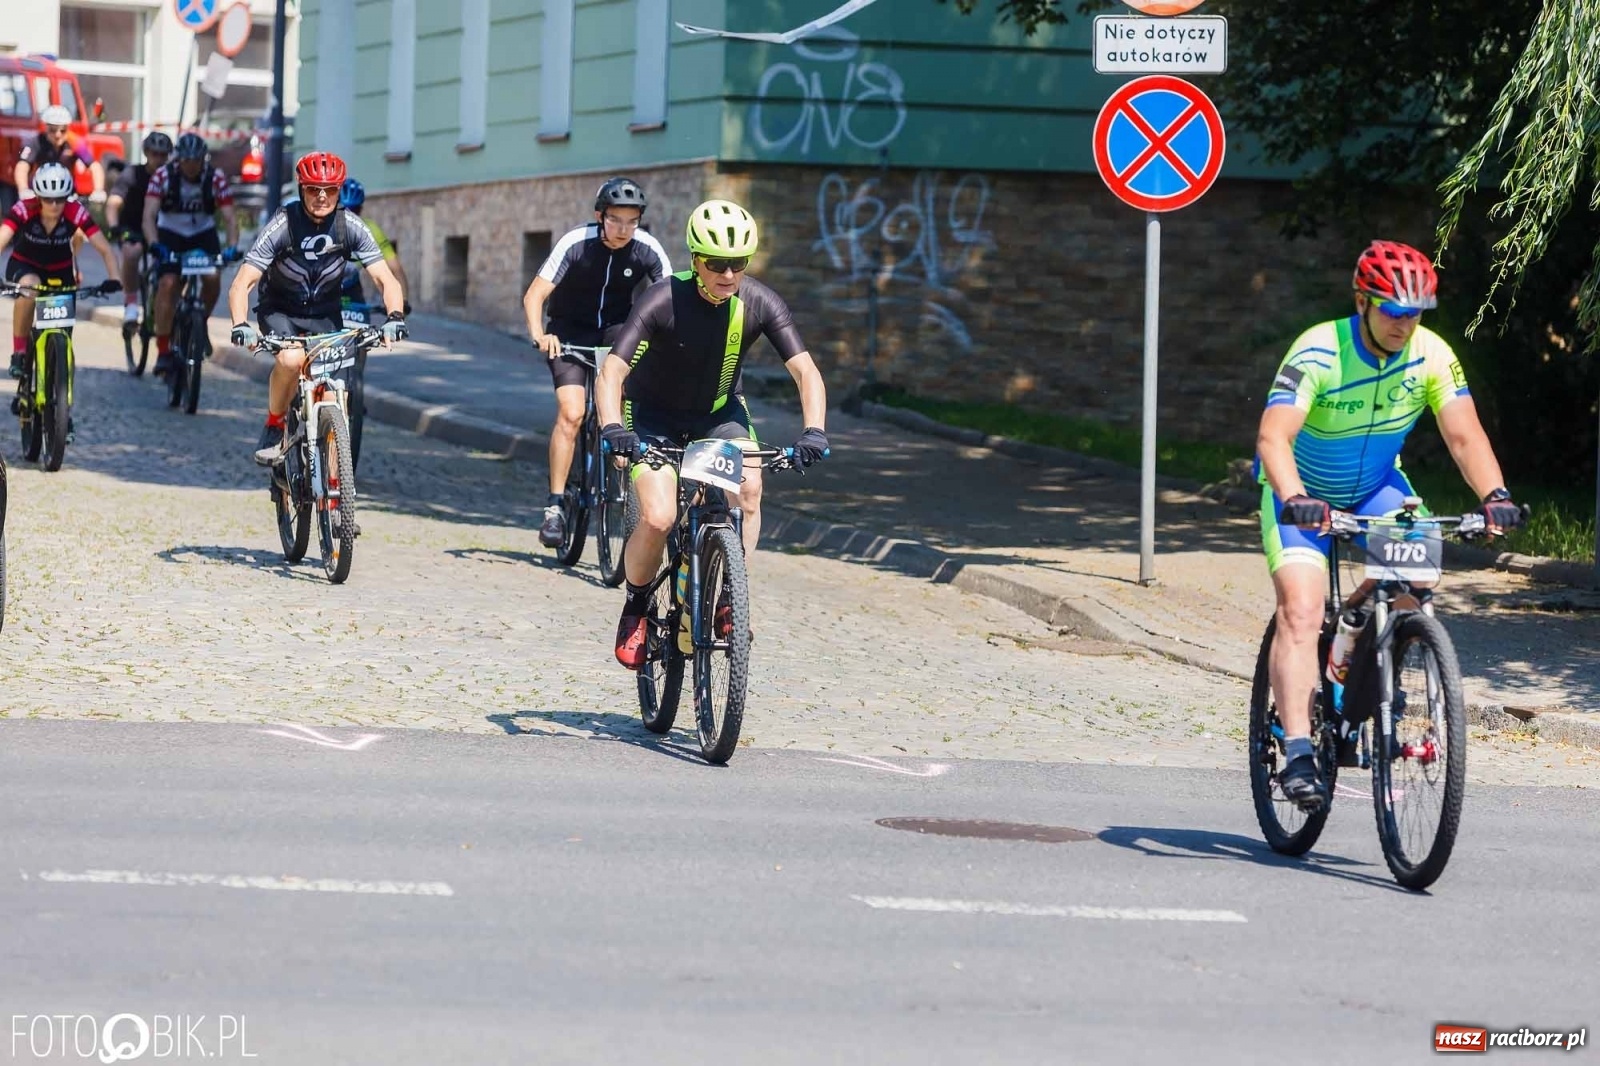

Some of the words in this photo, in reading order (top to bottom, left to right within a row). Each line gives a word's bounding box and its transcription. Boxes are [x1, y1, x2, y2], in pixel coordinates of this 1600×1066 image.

[1105, 24, 1136, 39] Nie
[1144, 24, 1216, 44] dotyczy
[1107, 47, 1208, 63] autokarów
[1316, 395, 1365, 415] Energo
[1383, 542, 1427, 563] 1170
